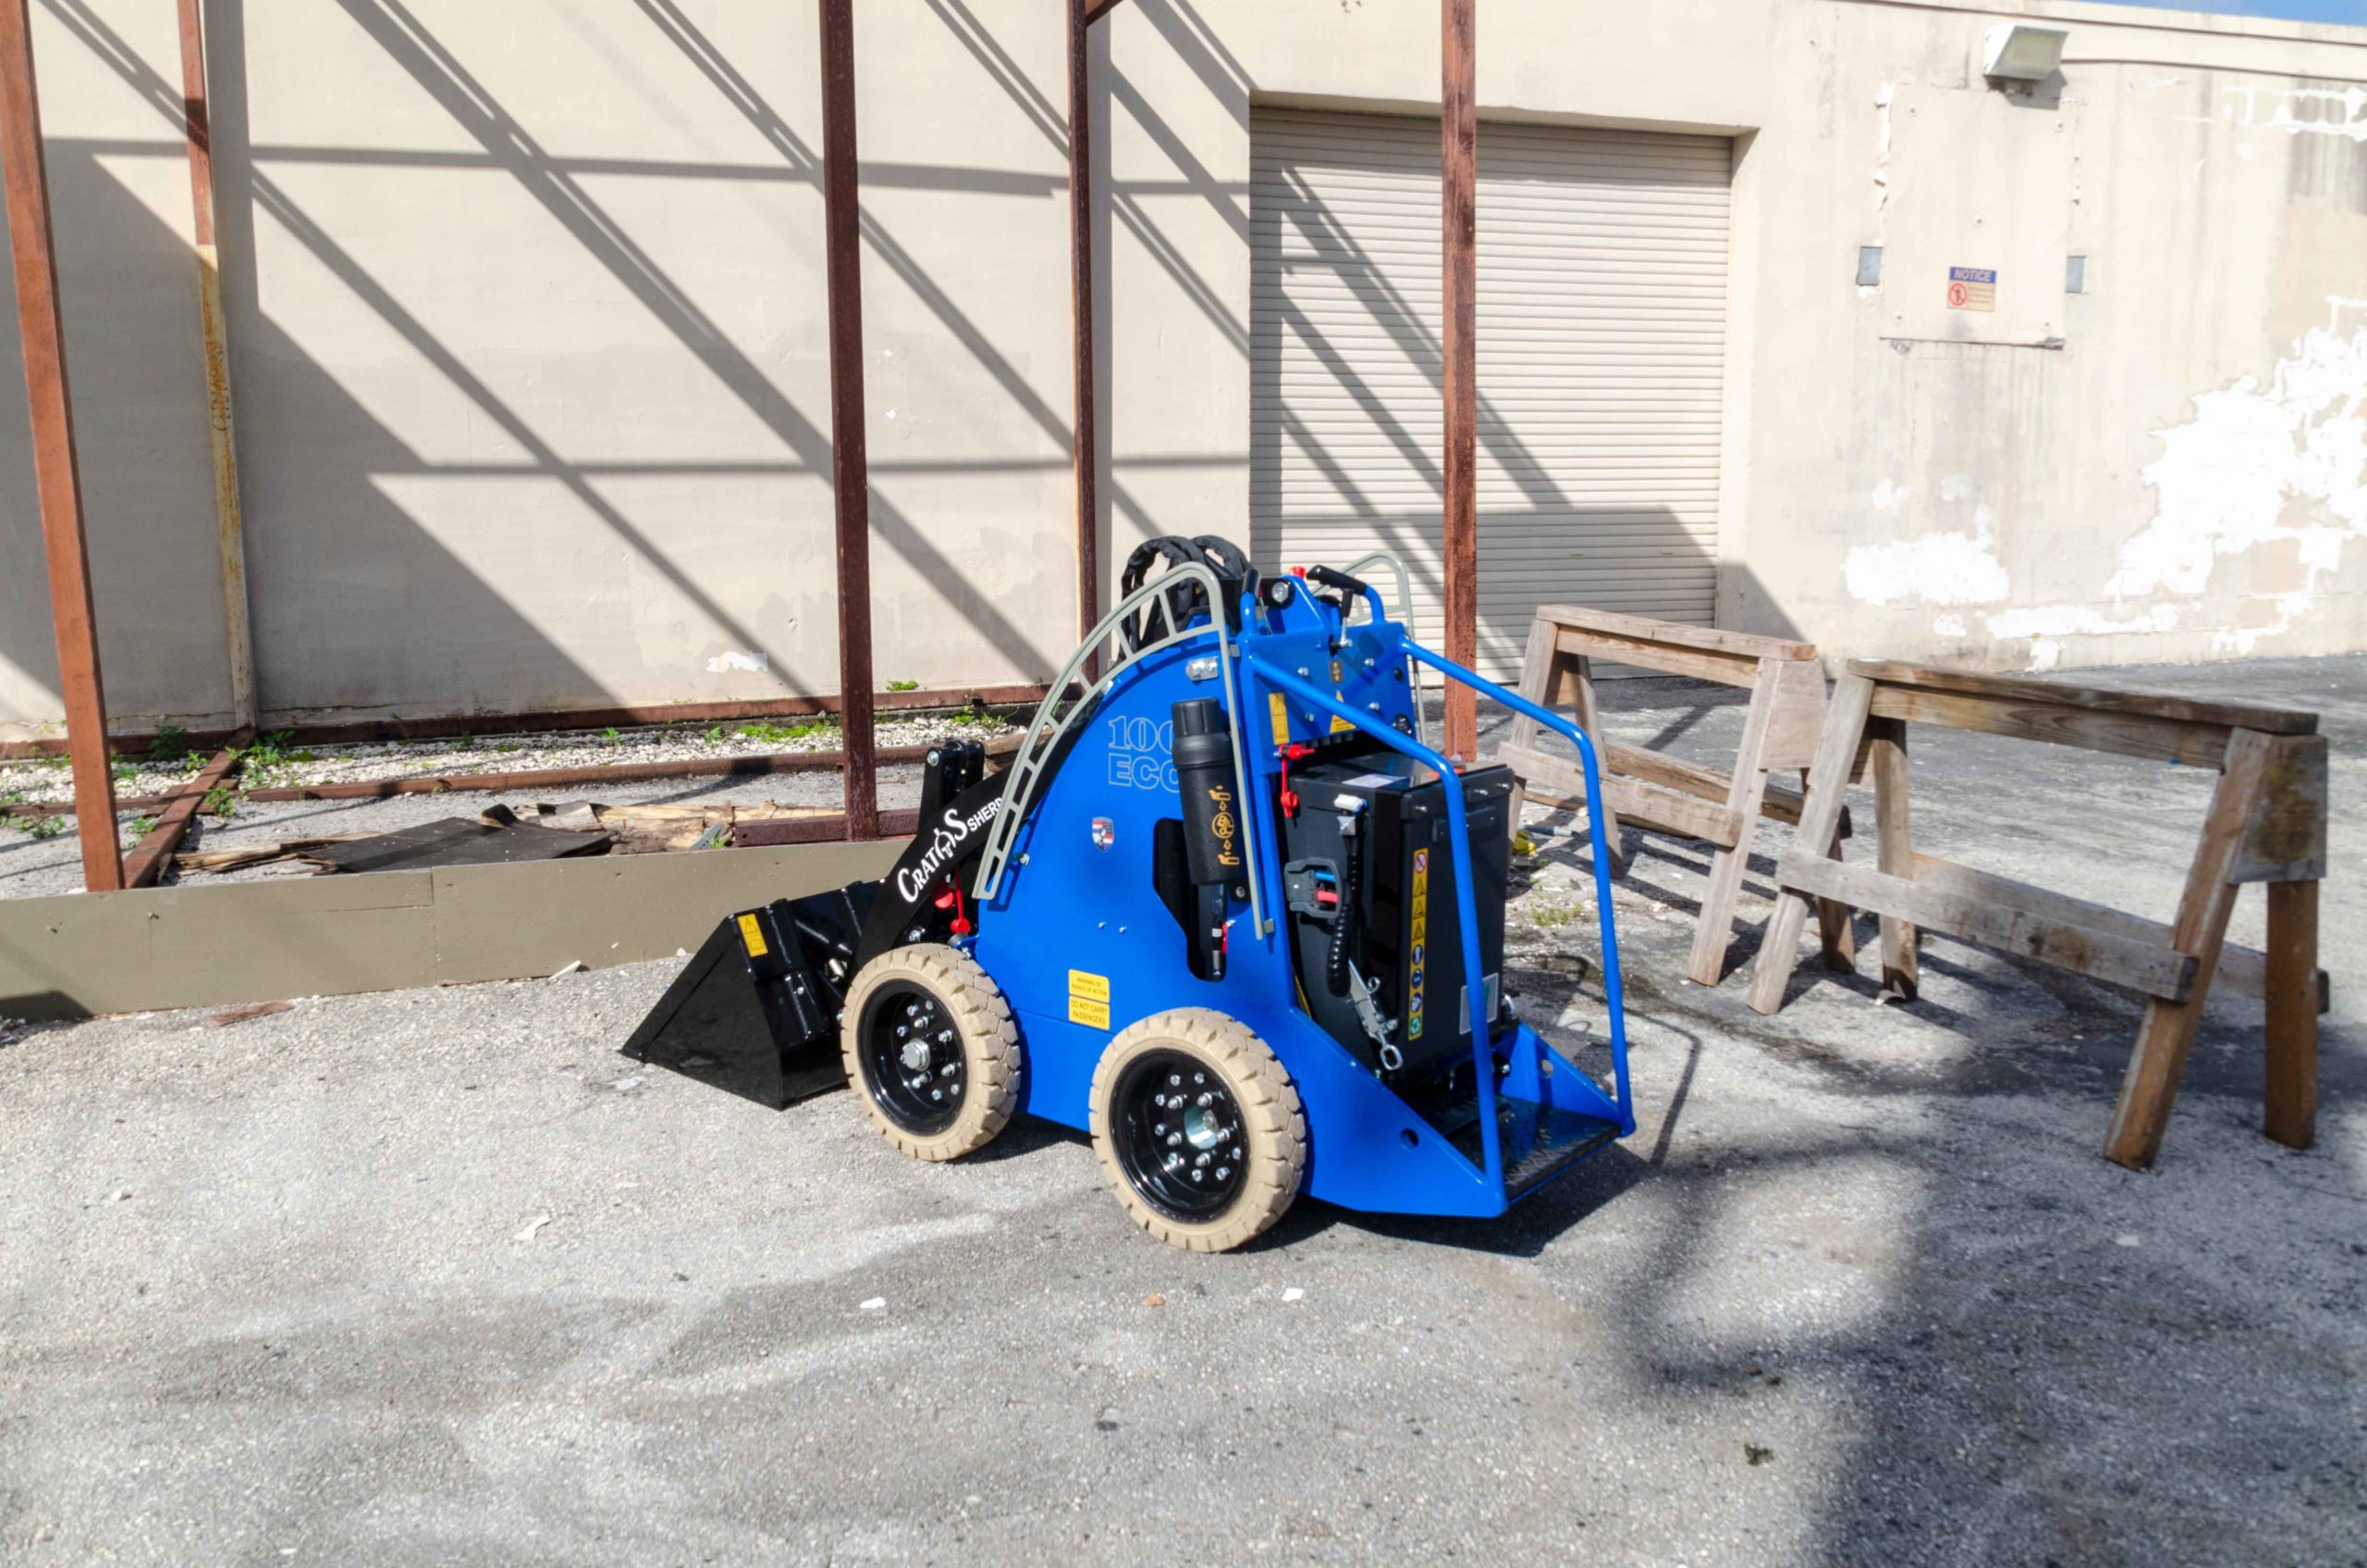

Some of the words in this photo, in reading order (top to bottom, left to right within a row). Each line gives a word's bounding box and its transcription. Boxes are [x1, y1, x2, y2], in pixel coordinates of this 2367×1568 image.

[1954, 268, 1991, 282] NOTICE
[1109, 753, 1180, 793] ECO
[1080, 1002, 1089, 1011] NOT
